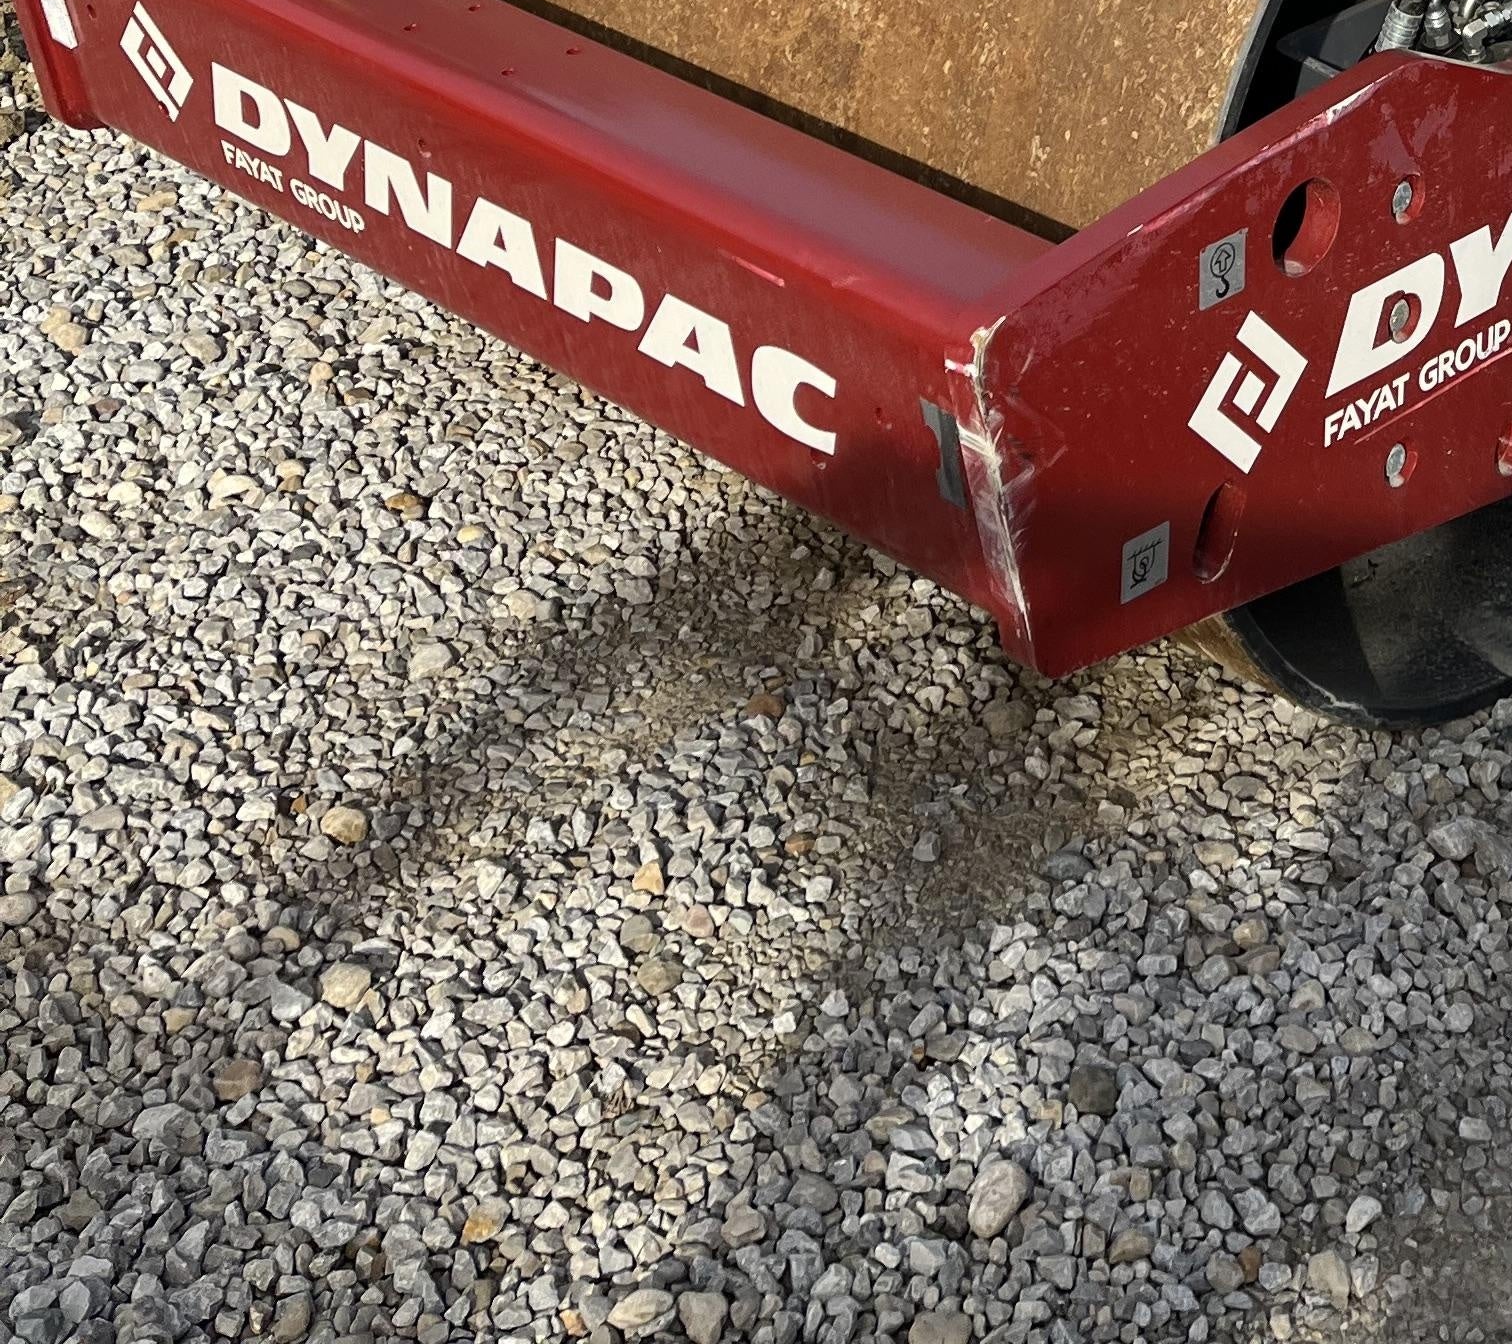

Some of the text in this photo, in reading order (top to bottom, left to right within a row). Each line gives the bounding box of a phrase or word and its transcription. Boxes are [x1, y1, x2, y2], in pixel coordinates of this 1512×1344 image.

[220, 139, 365, 235] FAYAT GROUP
[211, 61, 837, 456] DYNAPAC
[1323, 318, 1512, 449] FAYAT GROUP
